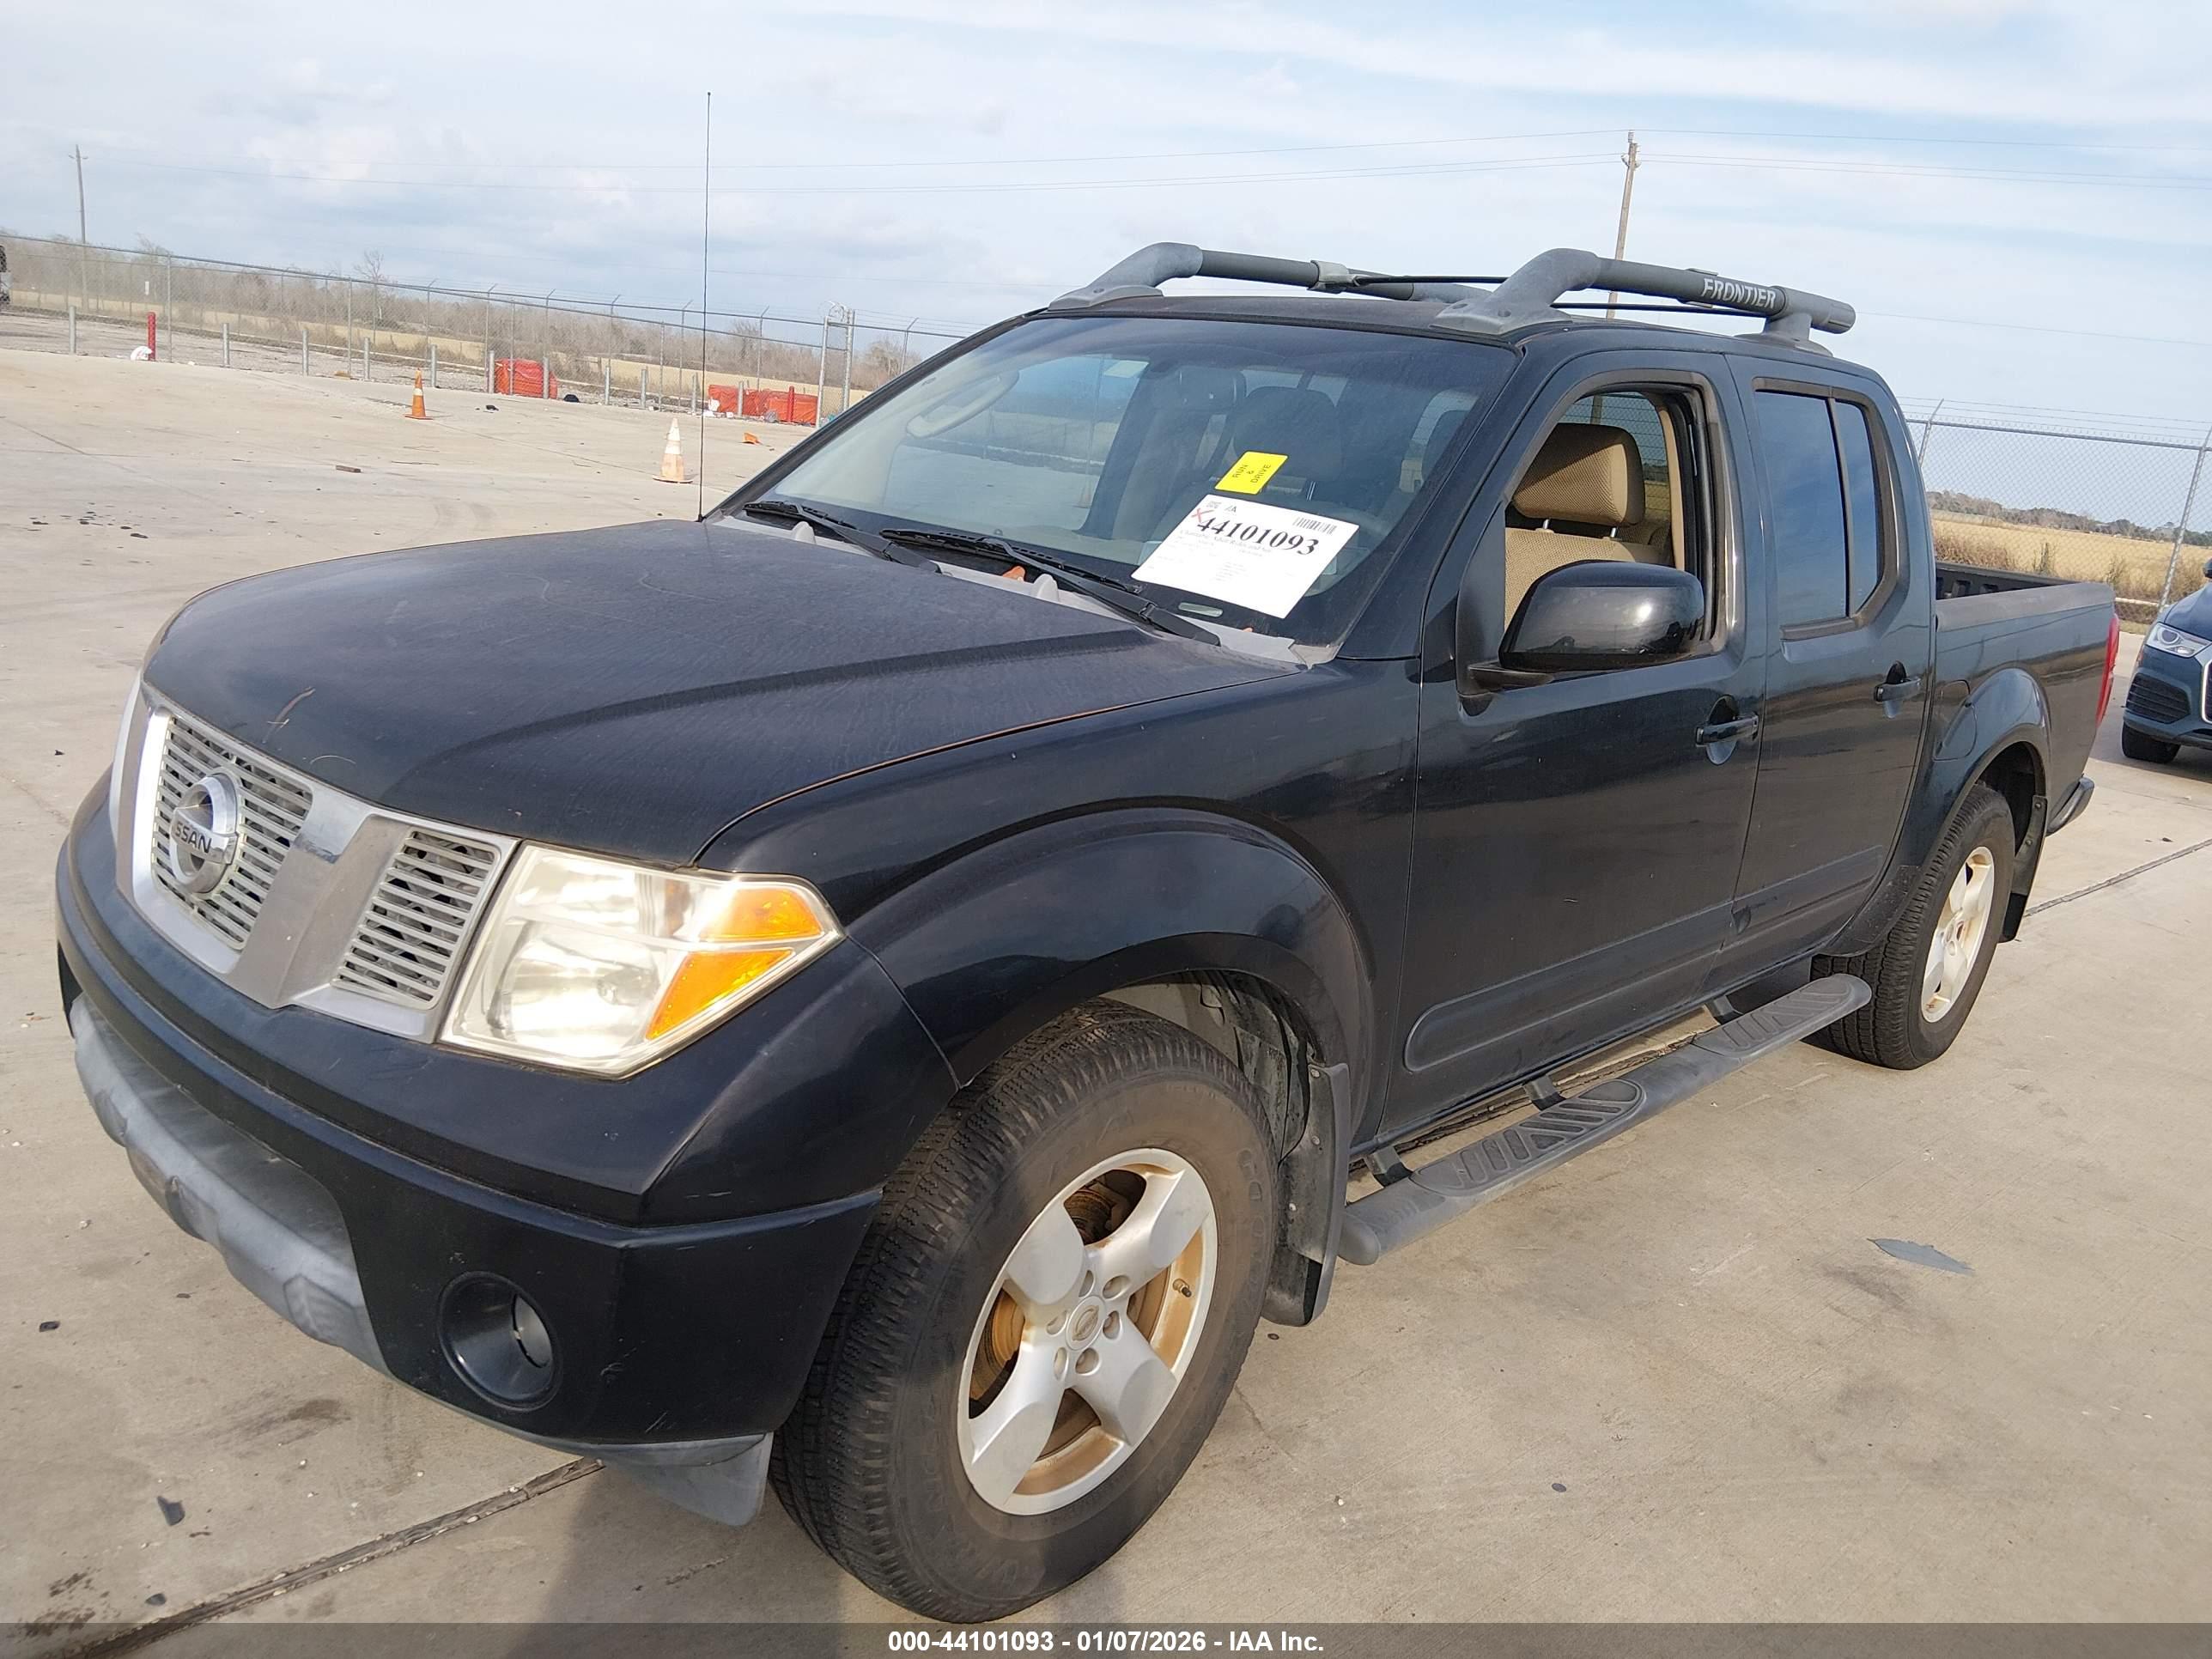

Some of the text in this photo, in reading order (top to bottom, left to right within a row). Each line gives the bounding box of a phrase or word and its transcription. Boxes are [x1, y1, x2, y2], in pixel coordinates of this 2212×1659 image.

[1700, 277, 1777, 308] FRONTIER
[1250, 464, 1272, 483] DRIVE
[1197, 517, 1320, 556] 44101093
[174, 822, 213, 854] SSAN
